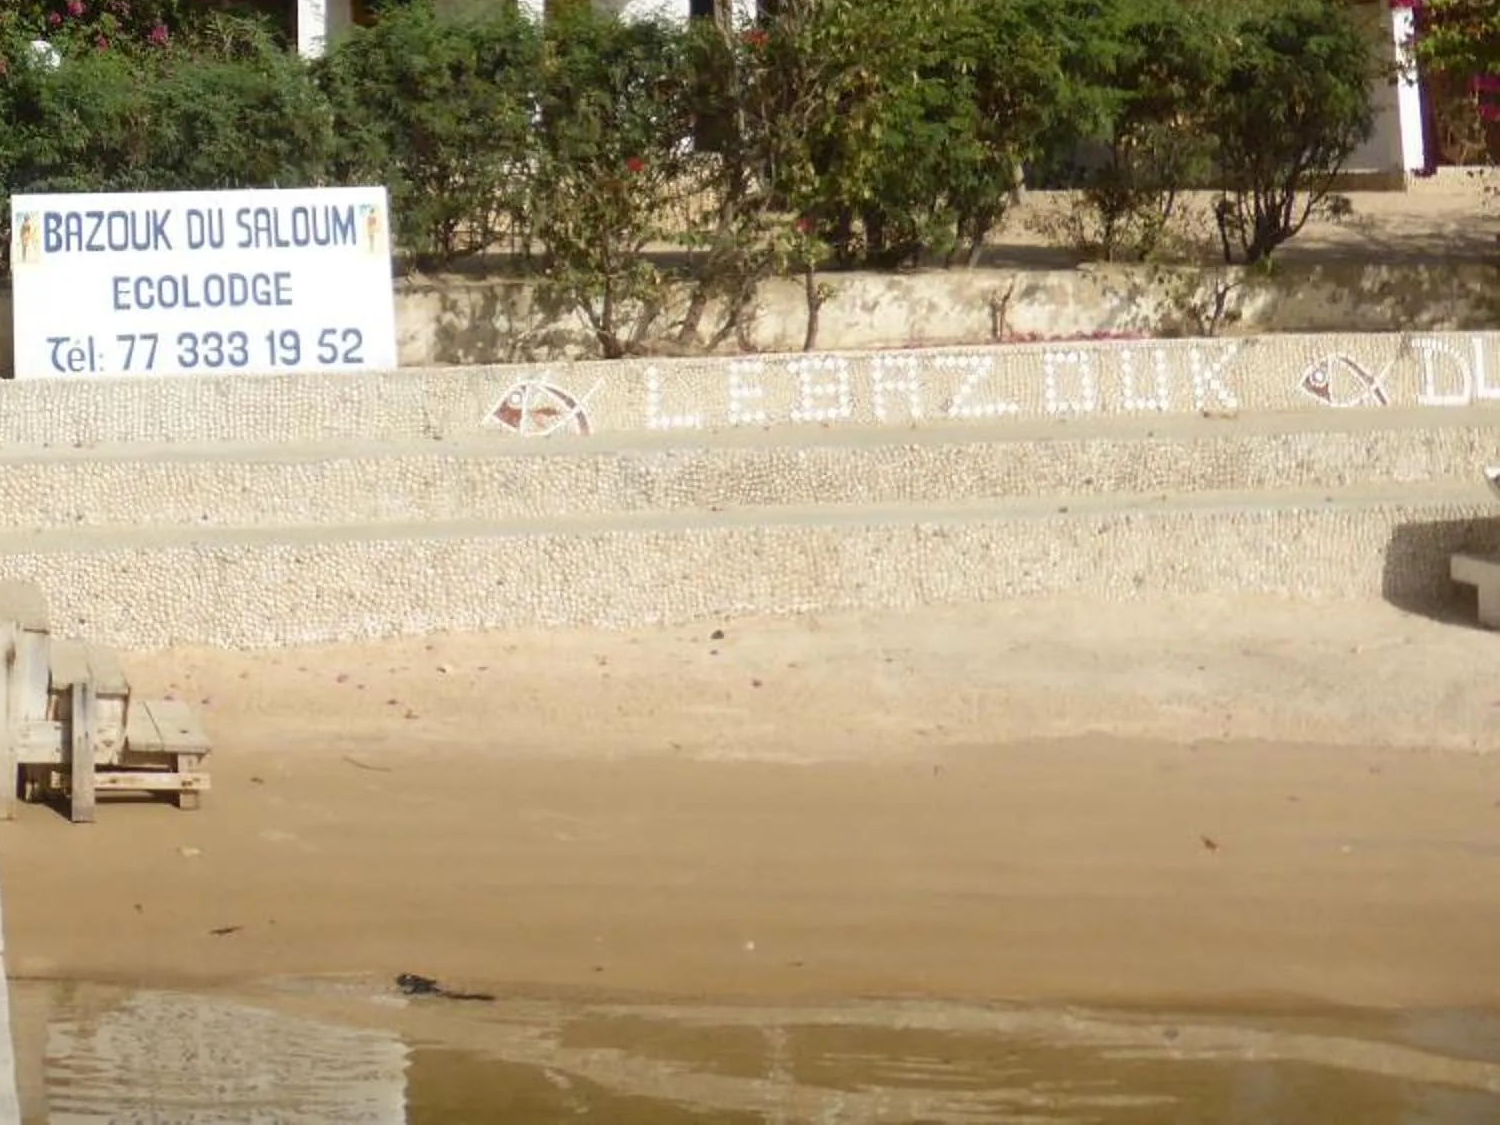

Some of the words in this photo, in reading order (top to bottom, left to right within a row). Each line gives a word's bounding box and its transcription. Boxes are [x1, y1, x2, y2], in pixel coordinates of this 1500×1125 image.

[44, 209, 173, 253] BAZOUK
[187, 207, 225, 250] DU
[236, 204, 357, 249] SALOUM
[113, 272, 293, 310] ECOLODGE
[116, 332, 159, 371] 77
[176, 329, 250, 368] 333
[264, 329, 301, 367] 19
[317, 327, 364, 365] 52
